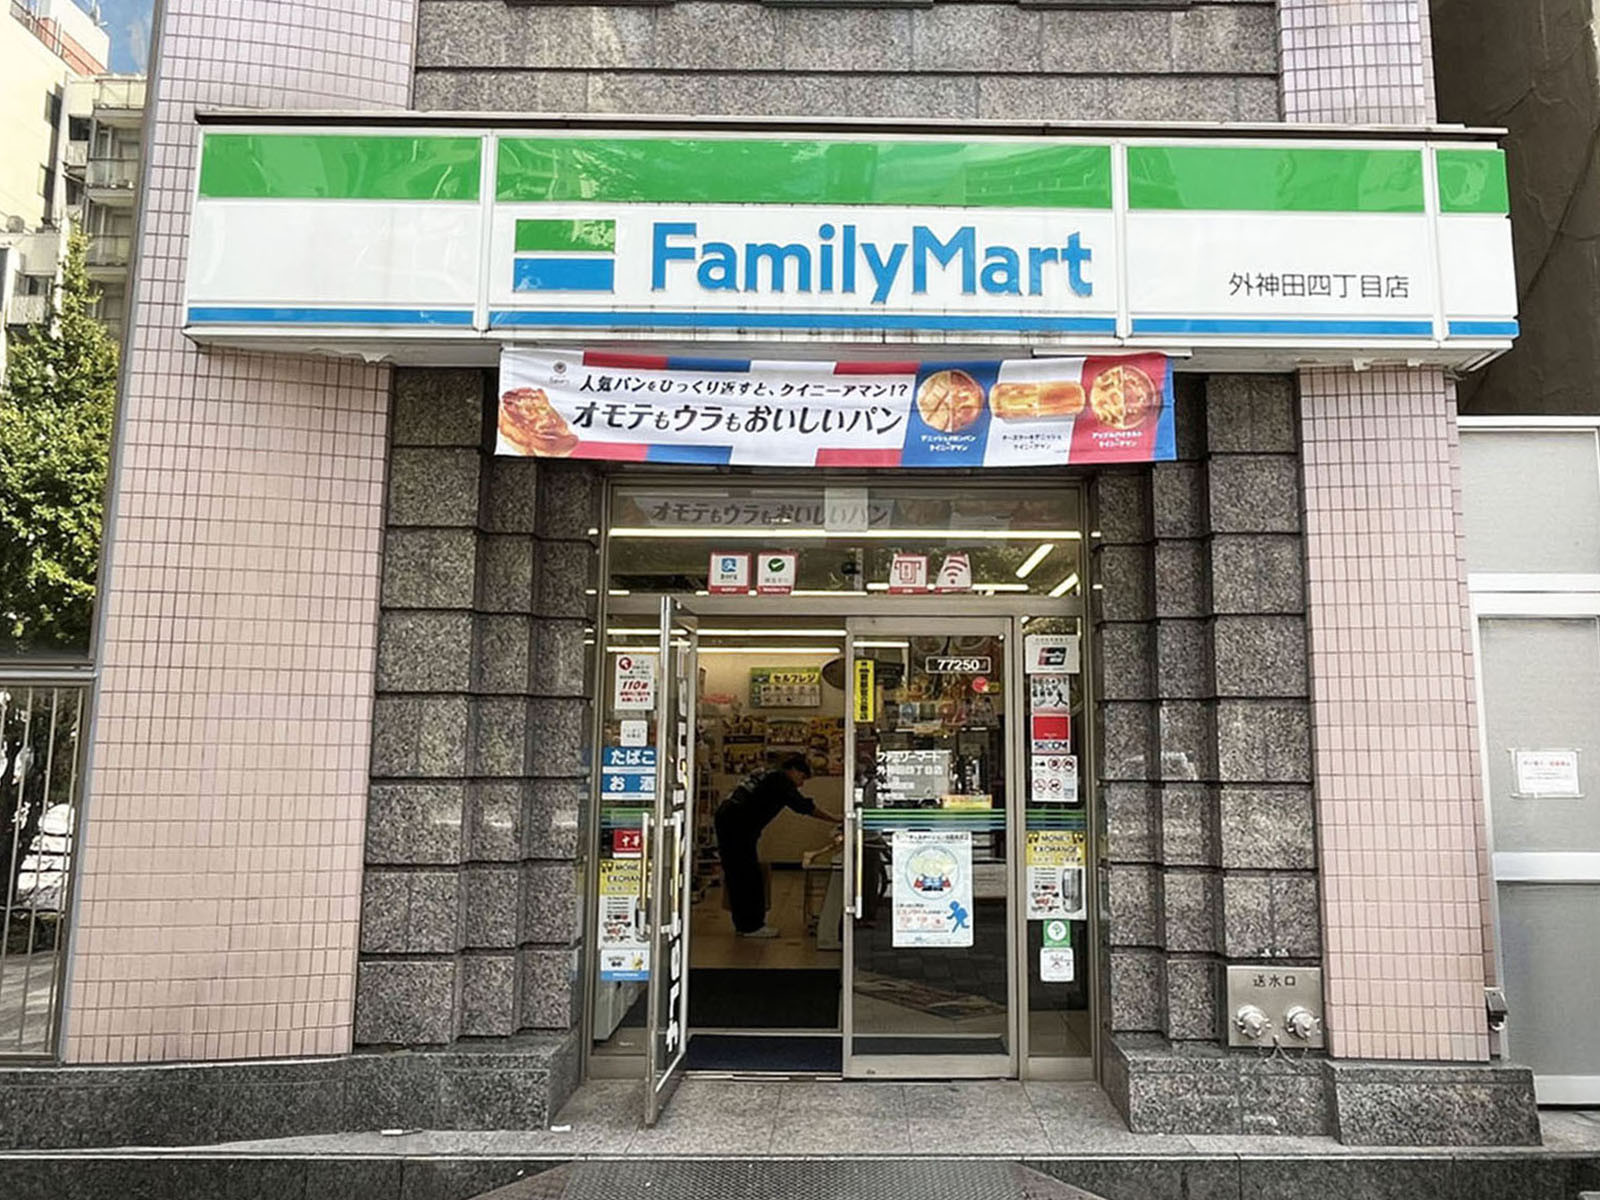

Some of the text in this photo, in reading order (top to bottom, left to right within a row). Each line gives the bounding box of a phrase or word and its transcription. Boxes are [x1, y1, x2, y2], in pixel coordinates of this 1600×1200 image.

[652, 221, 1092, 303] FamilyMart
[1228, 272, 1409, 298] 外神田四丁目店
[572, 401, 902, 435] オモテもウラもおいしいパン
[937, 659, 980, 671] 77250
[610, 749, 656, 766] たばこ
[1253, 974, 1296, 988] 送水口
